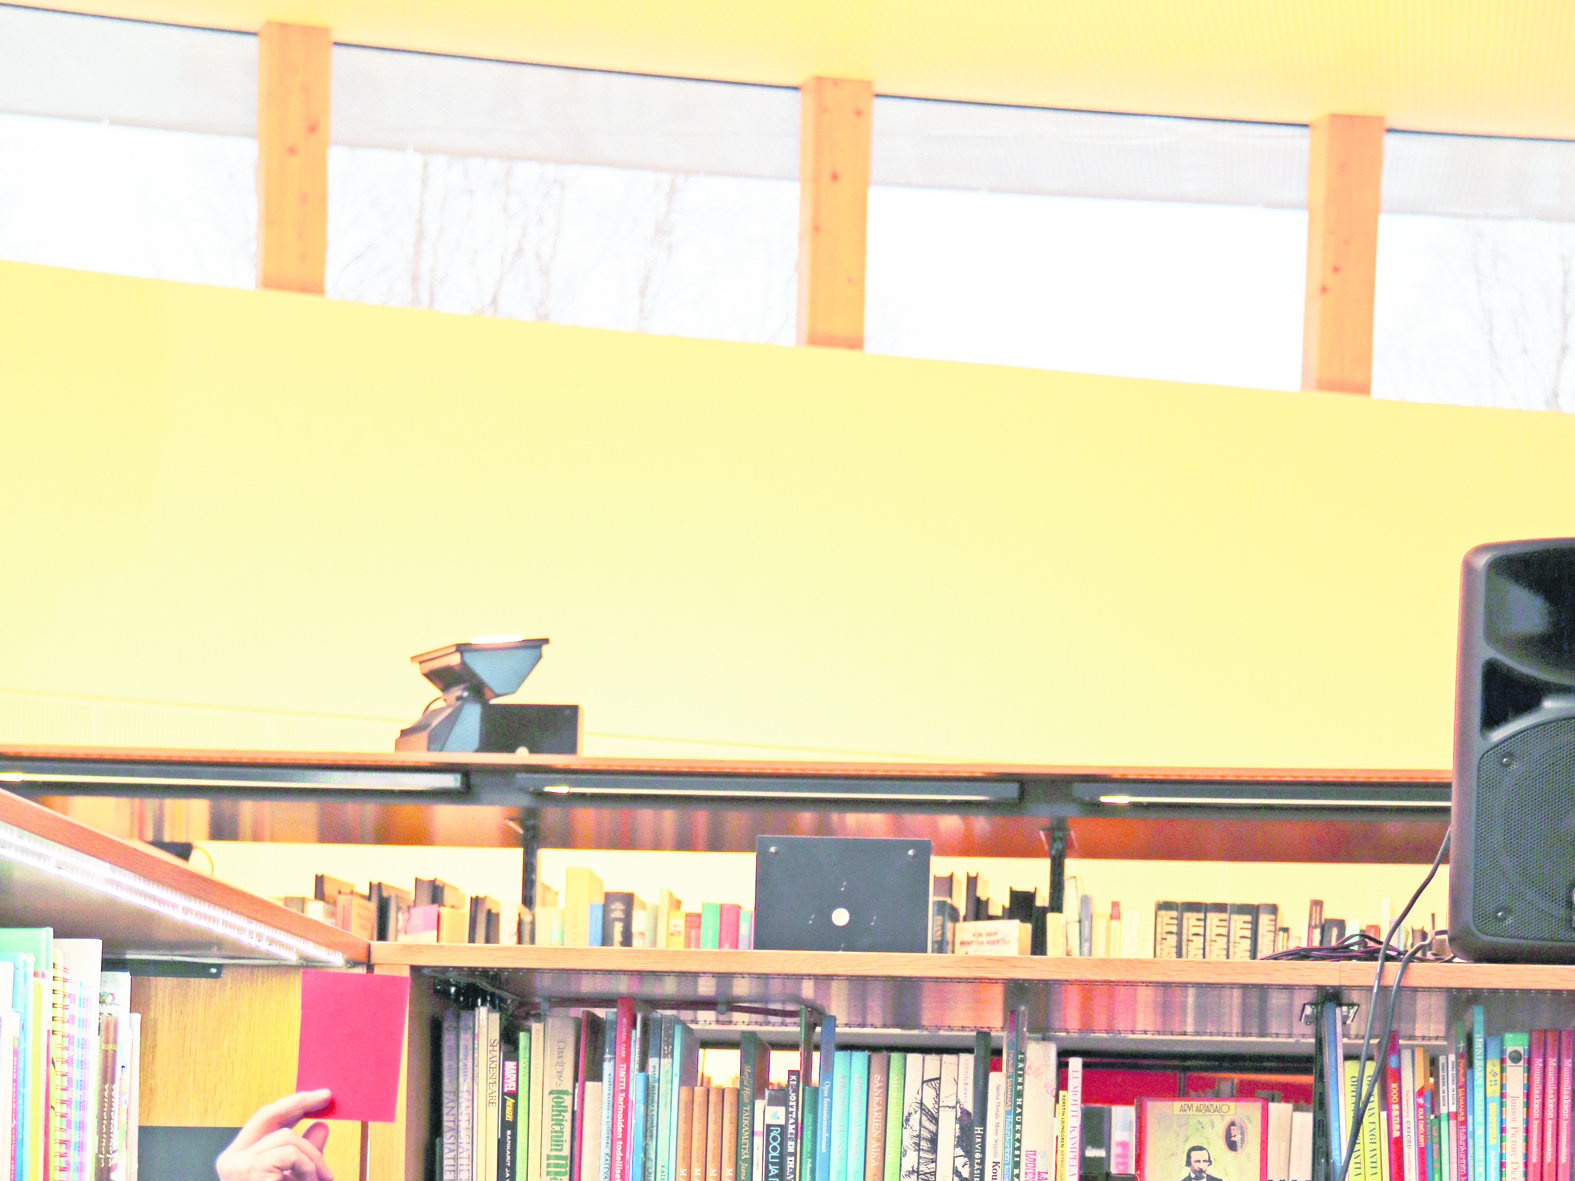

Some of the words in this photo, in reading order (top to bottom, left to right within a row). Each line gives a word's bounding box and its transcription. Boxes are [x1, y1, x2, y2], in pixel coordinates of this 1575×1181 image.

[487, 1038, 498, 1108] SHAKESPEARE
[504, 1061, 517, 1093] MARVEL
[618, 1063, 627, 1090] TINTTI
[822, 1081, 831, 1097] Opas
[1390, 1083, 1400, 1104] 1000
[1532, 1058, 1542, 1119] Muumilaakson
[1546, 1058, 1557, 1119] Muumilaakson
[1561, 1058, 1571, 1120] Muumilaakson
[616, 1092, 626, 1139] Tarinoiden
[872, 1074, 885, 1138] SANKARIEN
[1070, 1069, 1080, 1123] LUMOTTU
[1179, 1103, 1194, 1113] ARVI
[1509, 1094, 1520, 1124] Junior
[741, 1106, 751, 1159] TAIKAMETSÄ
[821, 1098, 830, 1153] fantasiamaailmaan
[888, 1074, 902, 1164] MERENKULKIJAT
[1014, 1098, 1023, 1162] HAUKKASI
[769, 1127, 781, 1162] ROOLI
[870, 1139, 882, 1167] AIKA
[1068, 1125, 1079, 1178] KAMPELA
[1458, 1125, 1467, 1175] Hullunkurinen
[1510, 1126, 1520, 1159] Picture
[1531, 1120, 1540, 1163] kuvasanakirja
[1545, 1120, 1554, 1163] kuvasanakirja
[1560, 1120, 1568, 1163] kuvasanakirja
[505, 1168, 511, 1178] JA
[768, 1164, 780, 1176] JA
[1025, 1150, 1037, 1181] ILOINEN
